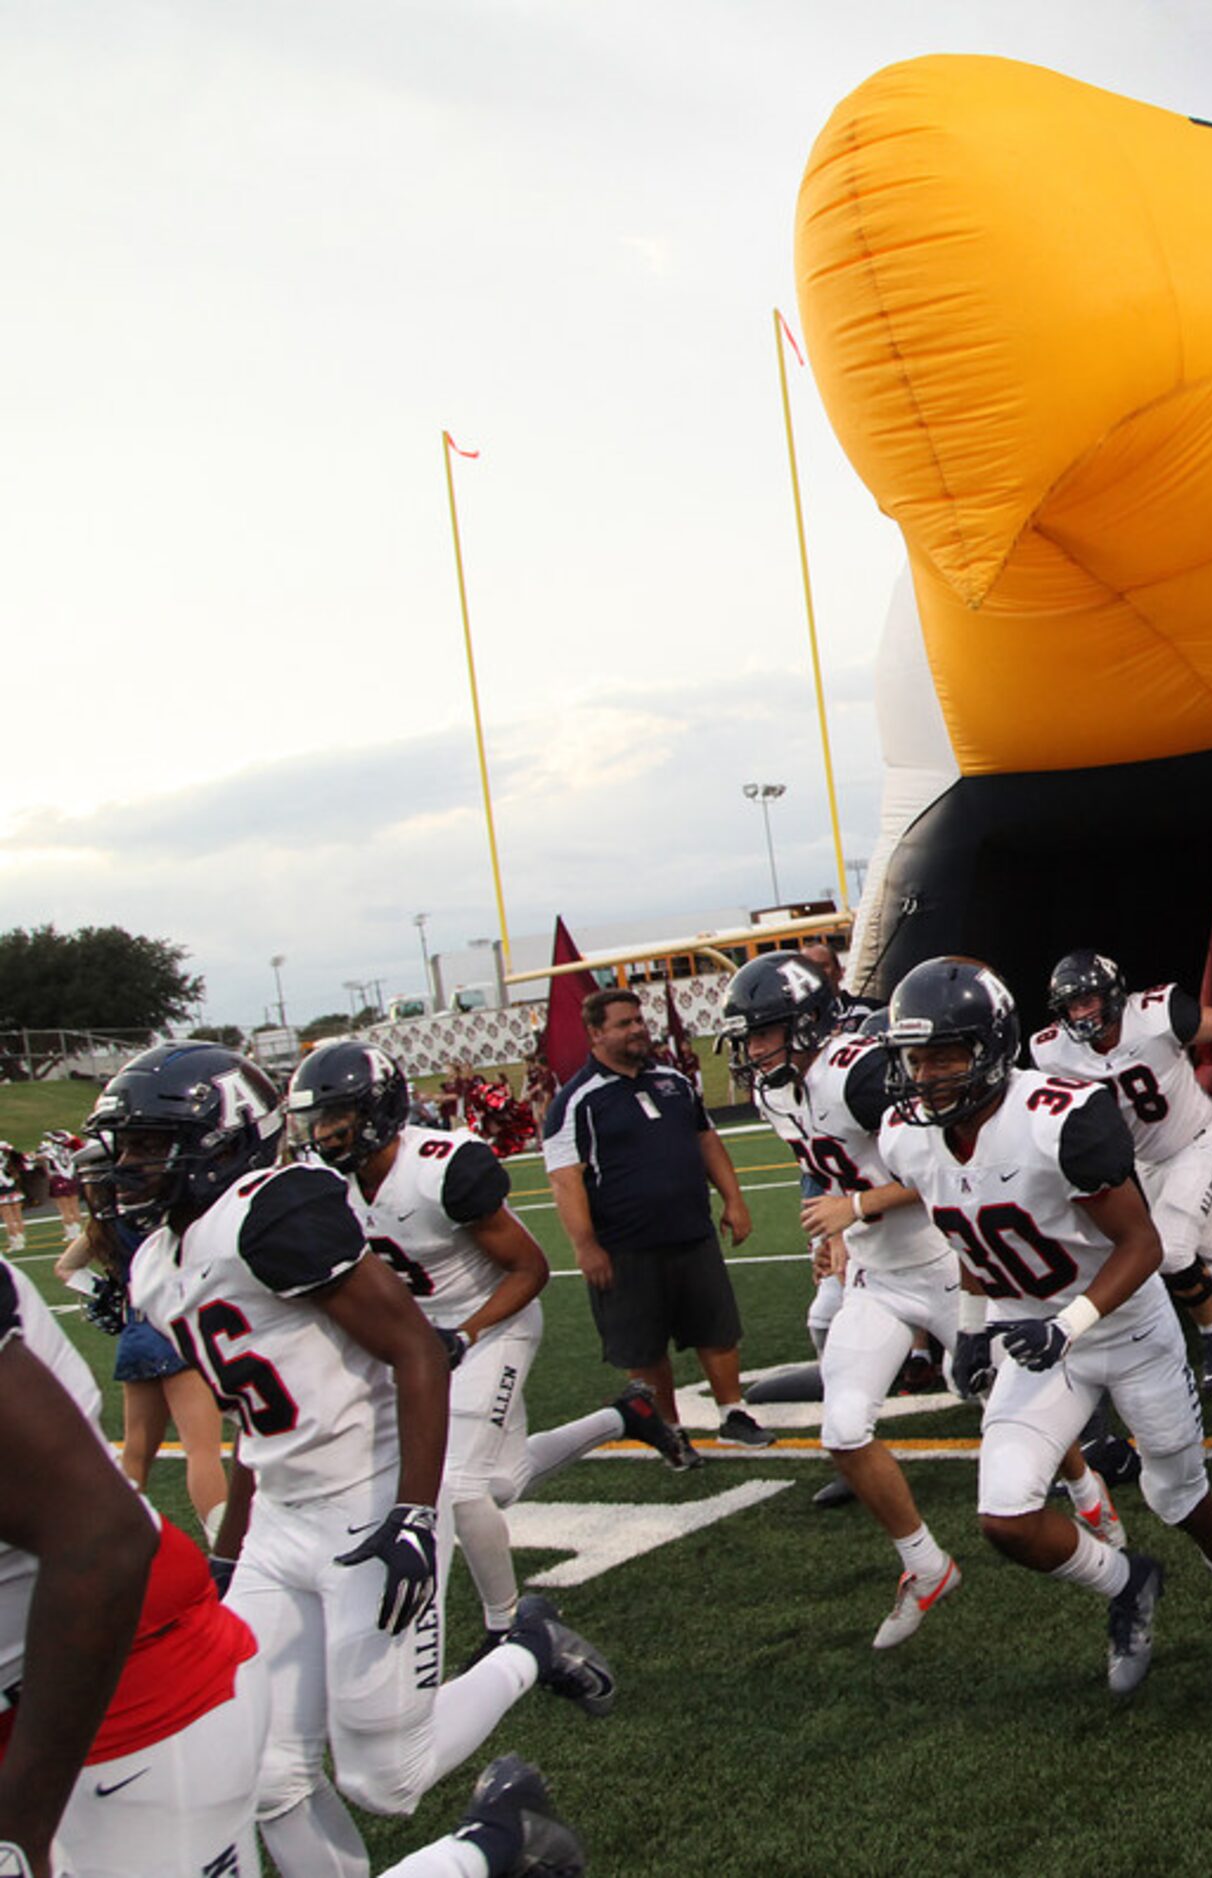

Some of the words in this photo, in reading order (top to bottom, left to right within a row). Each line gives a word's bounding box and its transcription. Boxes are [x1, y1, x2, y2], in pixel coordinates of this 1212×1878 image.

[777, 960, 822, 1003] A
[975, 968, 1015, 1017] A
[364, 1049, 395, 1081] A
[211, 1068, 268, 1132] A
[418, 1139, 454, 1160] 9
[932, 1201, 1079, 1300] 30
[490, 1365, 518, 1429] ALLEN
